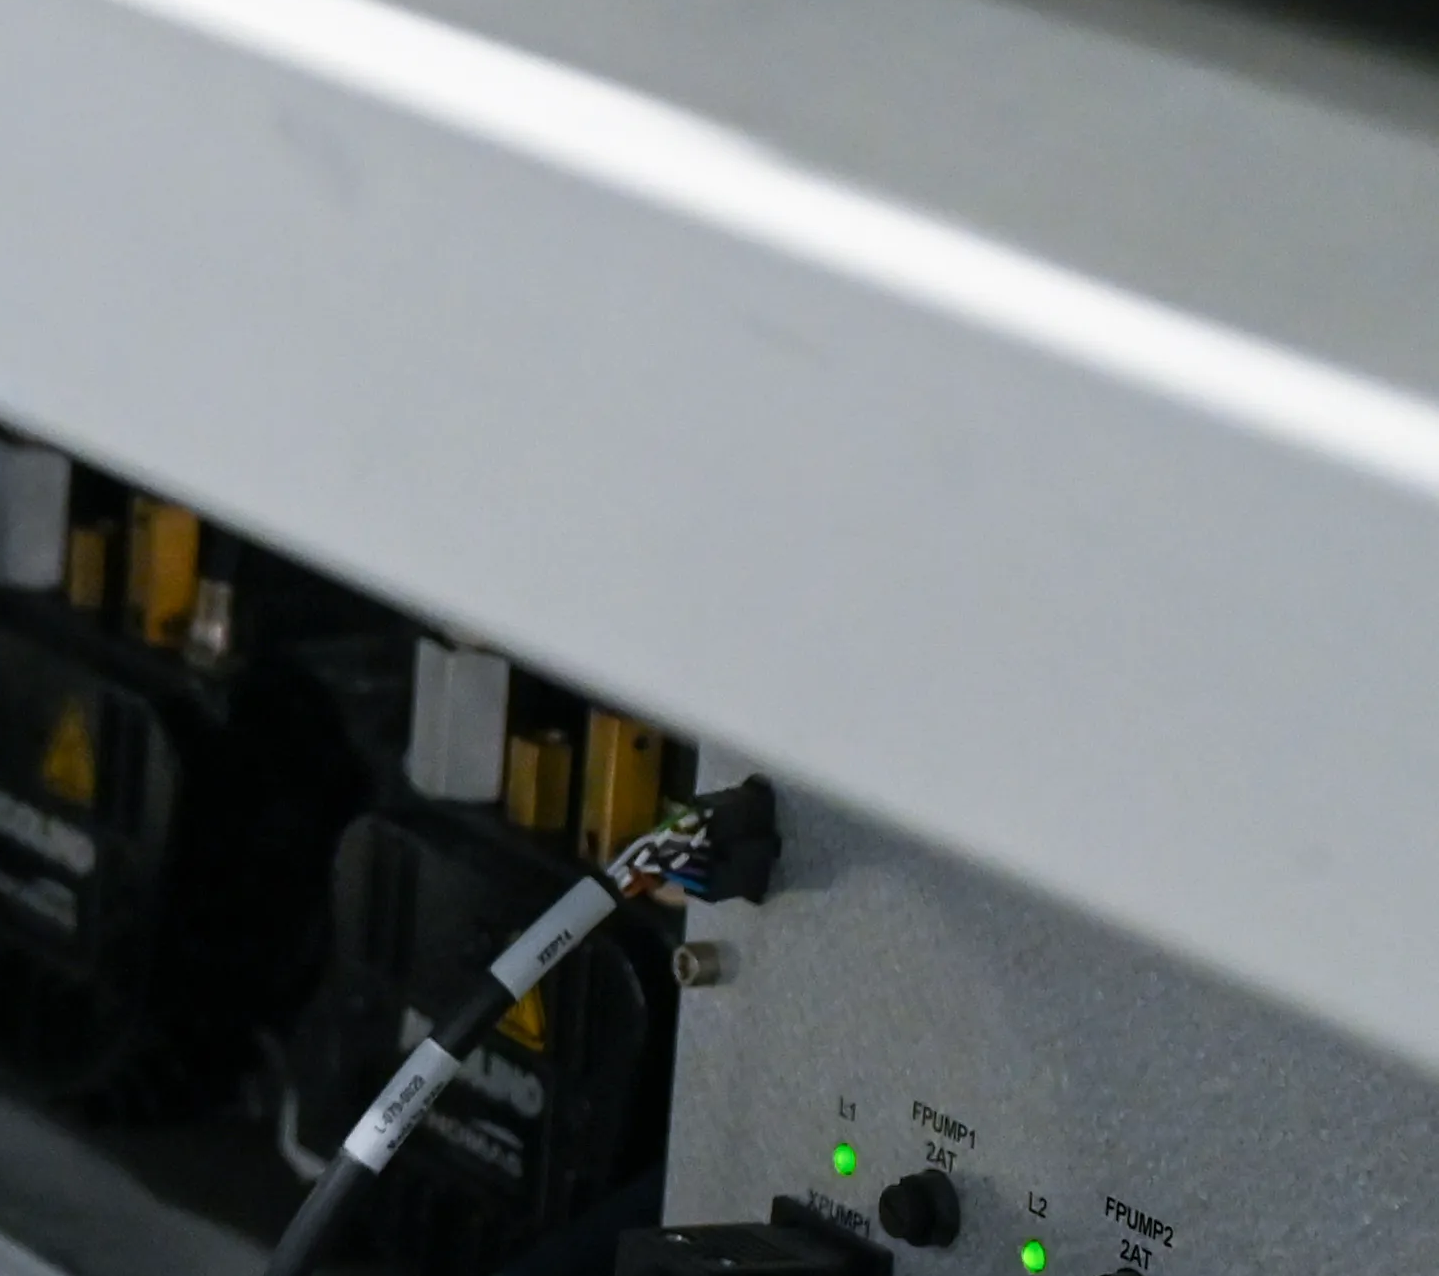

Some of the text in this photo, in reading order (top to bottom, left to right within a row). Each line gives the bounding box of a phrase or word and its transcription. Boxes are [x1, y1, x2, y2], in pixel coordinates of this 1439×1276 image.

[839, 1095, 856, 1121] L1
[912, 1100, 976, 1149] FPUMP1
[926, 1142, 958, 1172] 2AT
[808, 1188, 870, 1239] XPUMP1
[1028, 1191, 1048, 1218] L2
[1105, 1196, 1174, 1248] FPUMP2
[1120, 1239, 1152, 1270] 2AT
